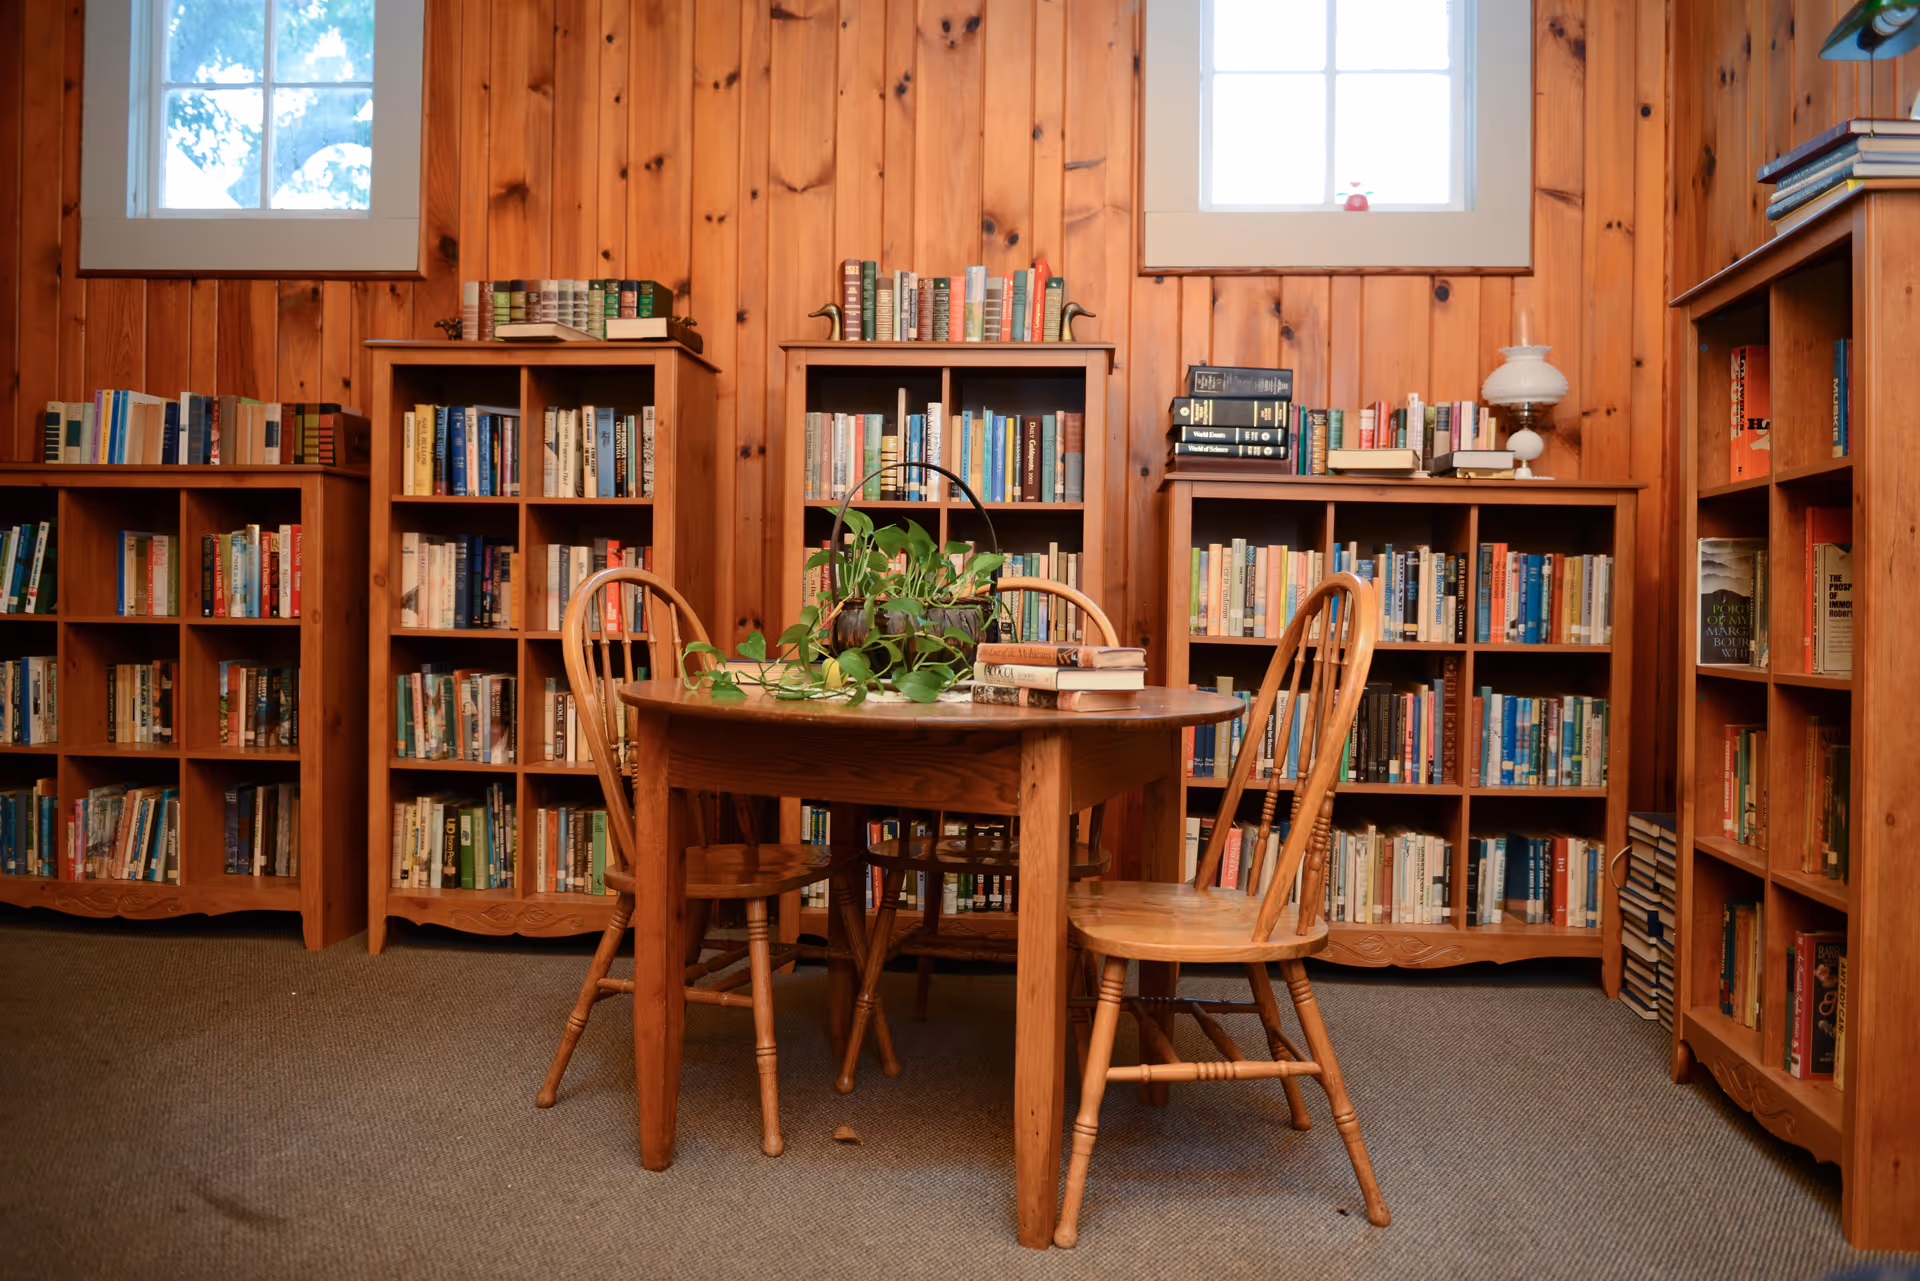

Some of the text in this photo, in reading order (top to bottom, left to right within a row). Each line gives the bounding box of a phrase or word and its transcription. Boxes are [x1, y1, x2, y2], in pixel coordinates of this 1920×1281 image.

[1027, 439, 1037, 472] Guideposts
[1435, 556, 1444, 573] High
[1829, 574, 1842, 582] THE
[1436, 574, 1444, 595] Blood
[1829, 583, 1853, 591] PROSP
[1829, 592, 1838, 600] OF
[1712, 604, 1750, 614] PORT
[1728, 615, 1748, 625] MY
[1706, 627, 1747, 636] MARG
[1713, 638, 1749, 647] BOUR
